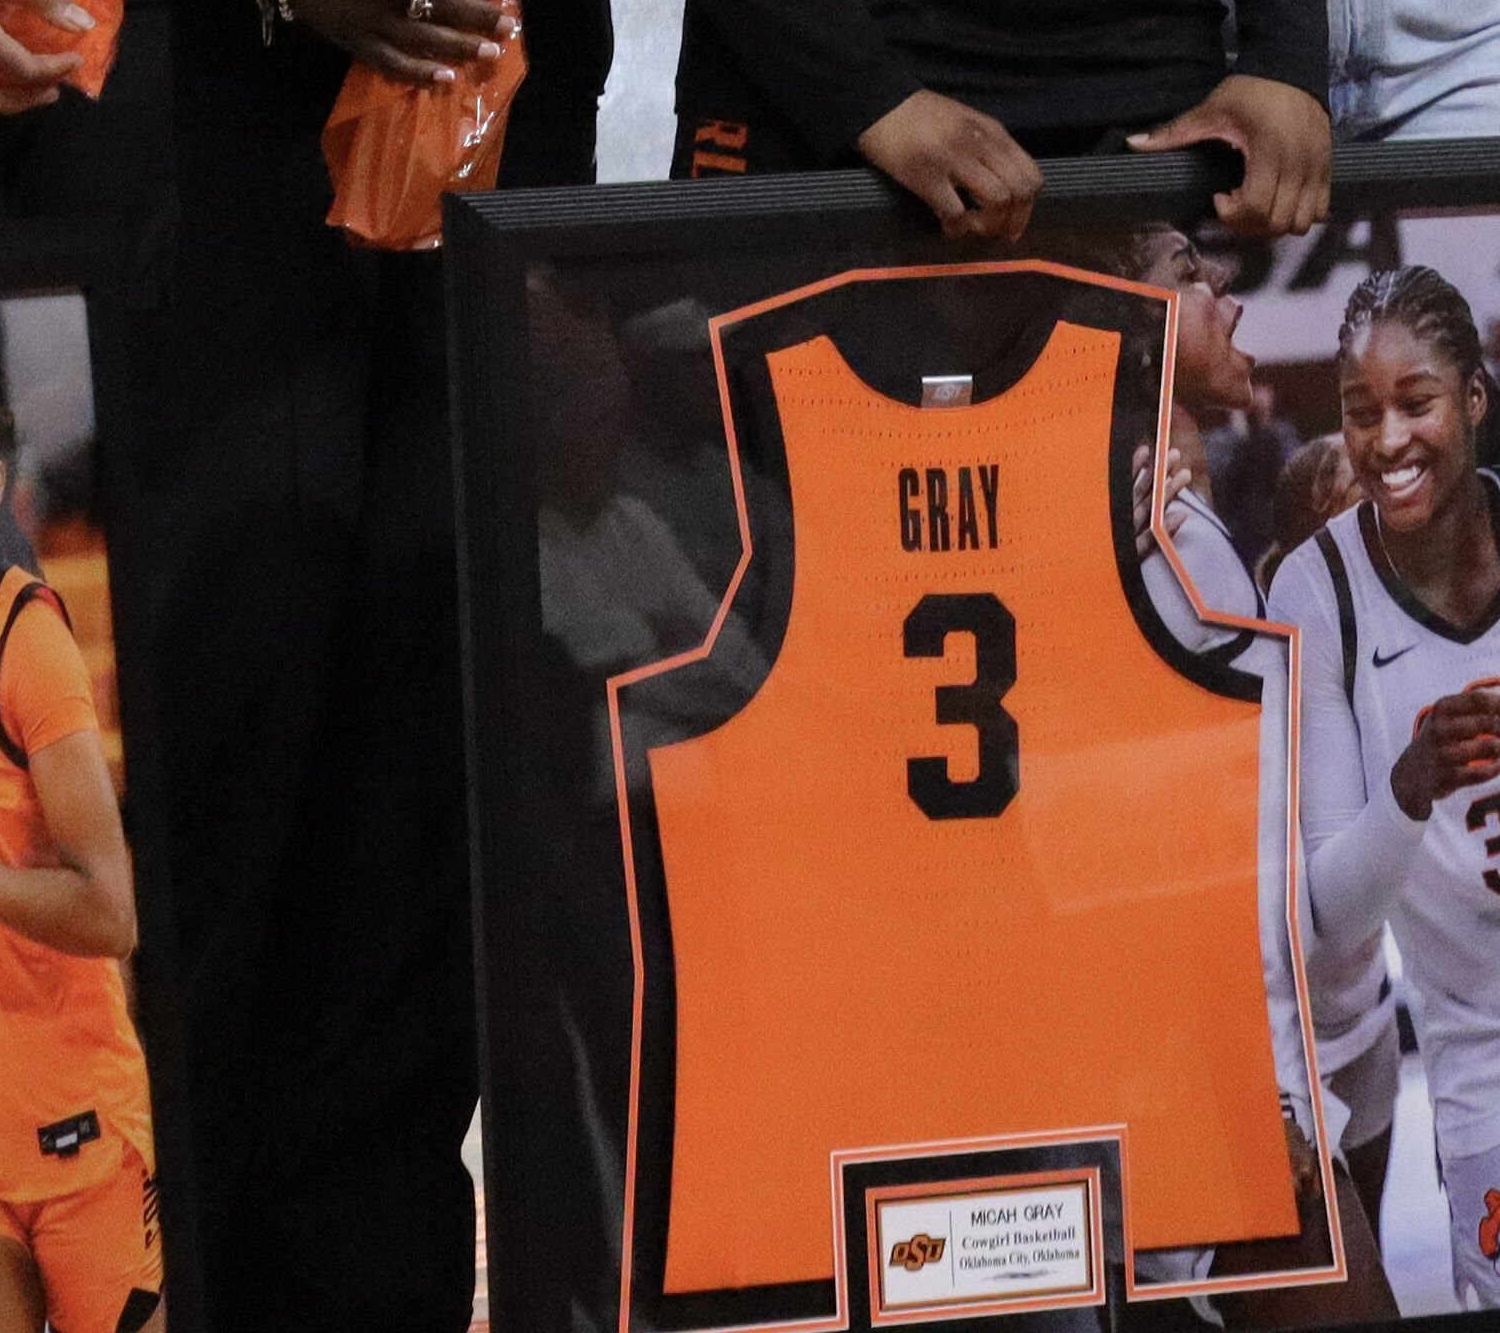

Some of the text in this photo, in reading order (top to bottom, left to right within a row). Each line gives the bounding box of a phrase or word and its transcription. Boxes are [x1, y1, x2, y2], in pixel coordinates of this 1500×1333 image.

[898, 464, 1000, 552] GRAY
[902, 591, 1021, 822] 3
[970, 1202, 1065, 1227] MICAH GRAY
[889, 1232, 948, 1271] OSU
[961, 1226, 1077, 1253] Cowgirl Basketball
[958, 1247, 1080, 1271] Oklahoma City, Oklahoma
